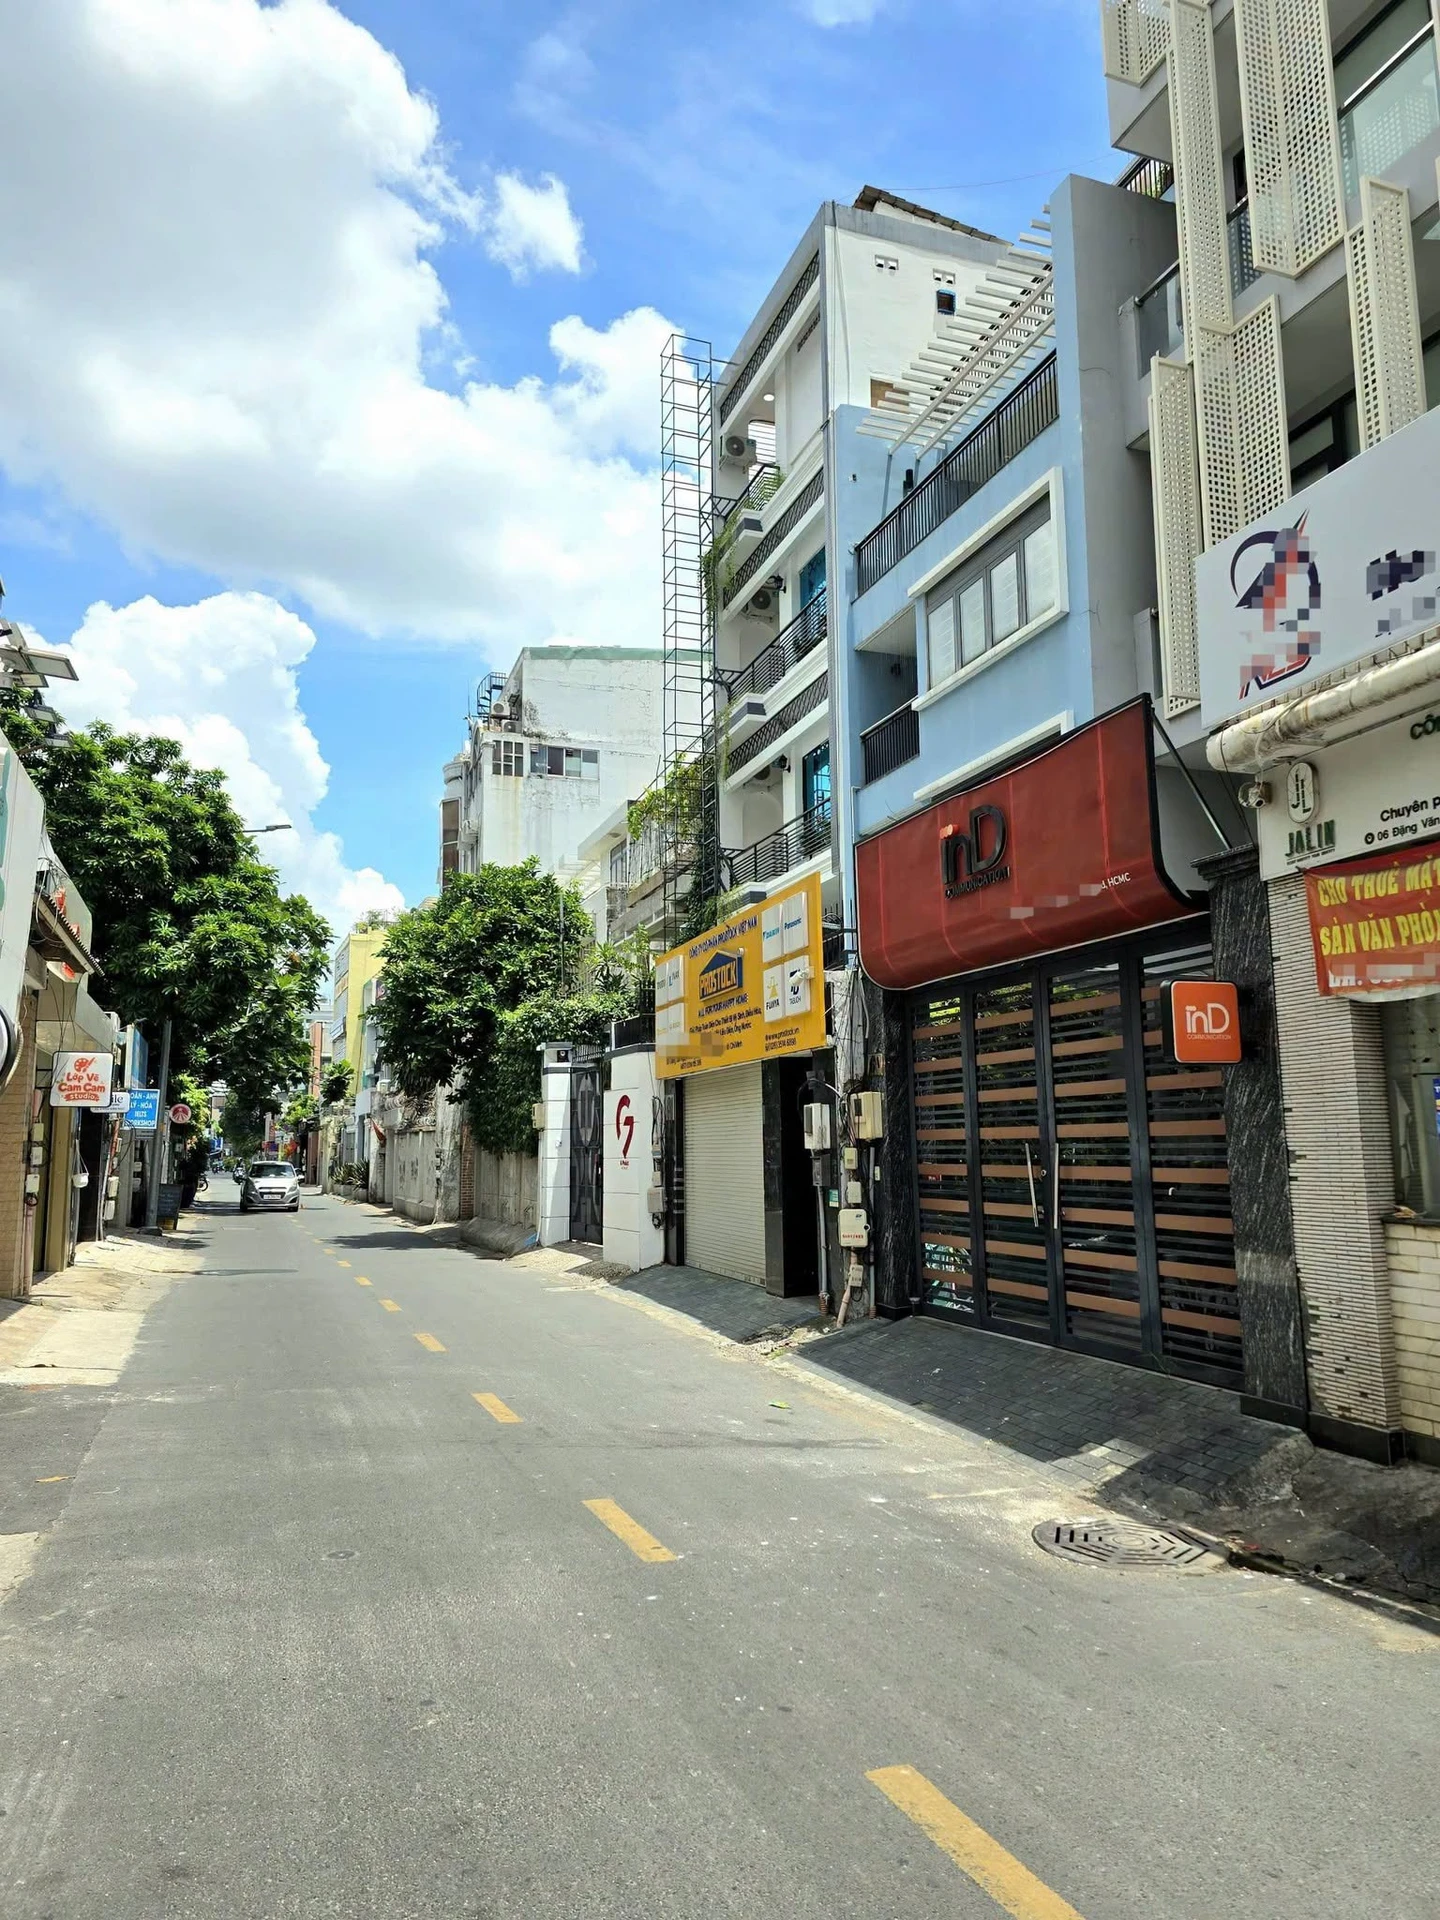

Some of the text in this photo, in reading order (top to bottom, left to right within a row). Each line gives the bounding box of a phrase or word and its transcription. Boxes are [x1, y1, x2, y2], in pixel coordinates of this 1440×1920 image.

[1380, 800, 1428, 822] Chuyên
[1285, 819, 1336, 857] JALIN
[1377, 816, 1440, 841] 06 Đặng Văn
[945, 866, 1011, 900] COMMUNICATION
[1107, 872, 1131, 887] HCMC
[1317, 876, 1348, 907] CHO
[1319, 916, 1357, 956] SÀN
[1358, 913, 1396, 951] VĂN
[700, 960, 737, 998] PROSTOCK
[1185, 1003, 1230, 1033] inD
[58, 1083, 105, 1093] Cam Cam
[66, 1072, 84, 1083] Lớp
